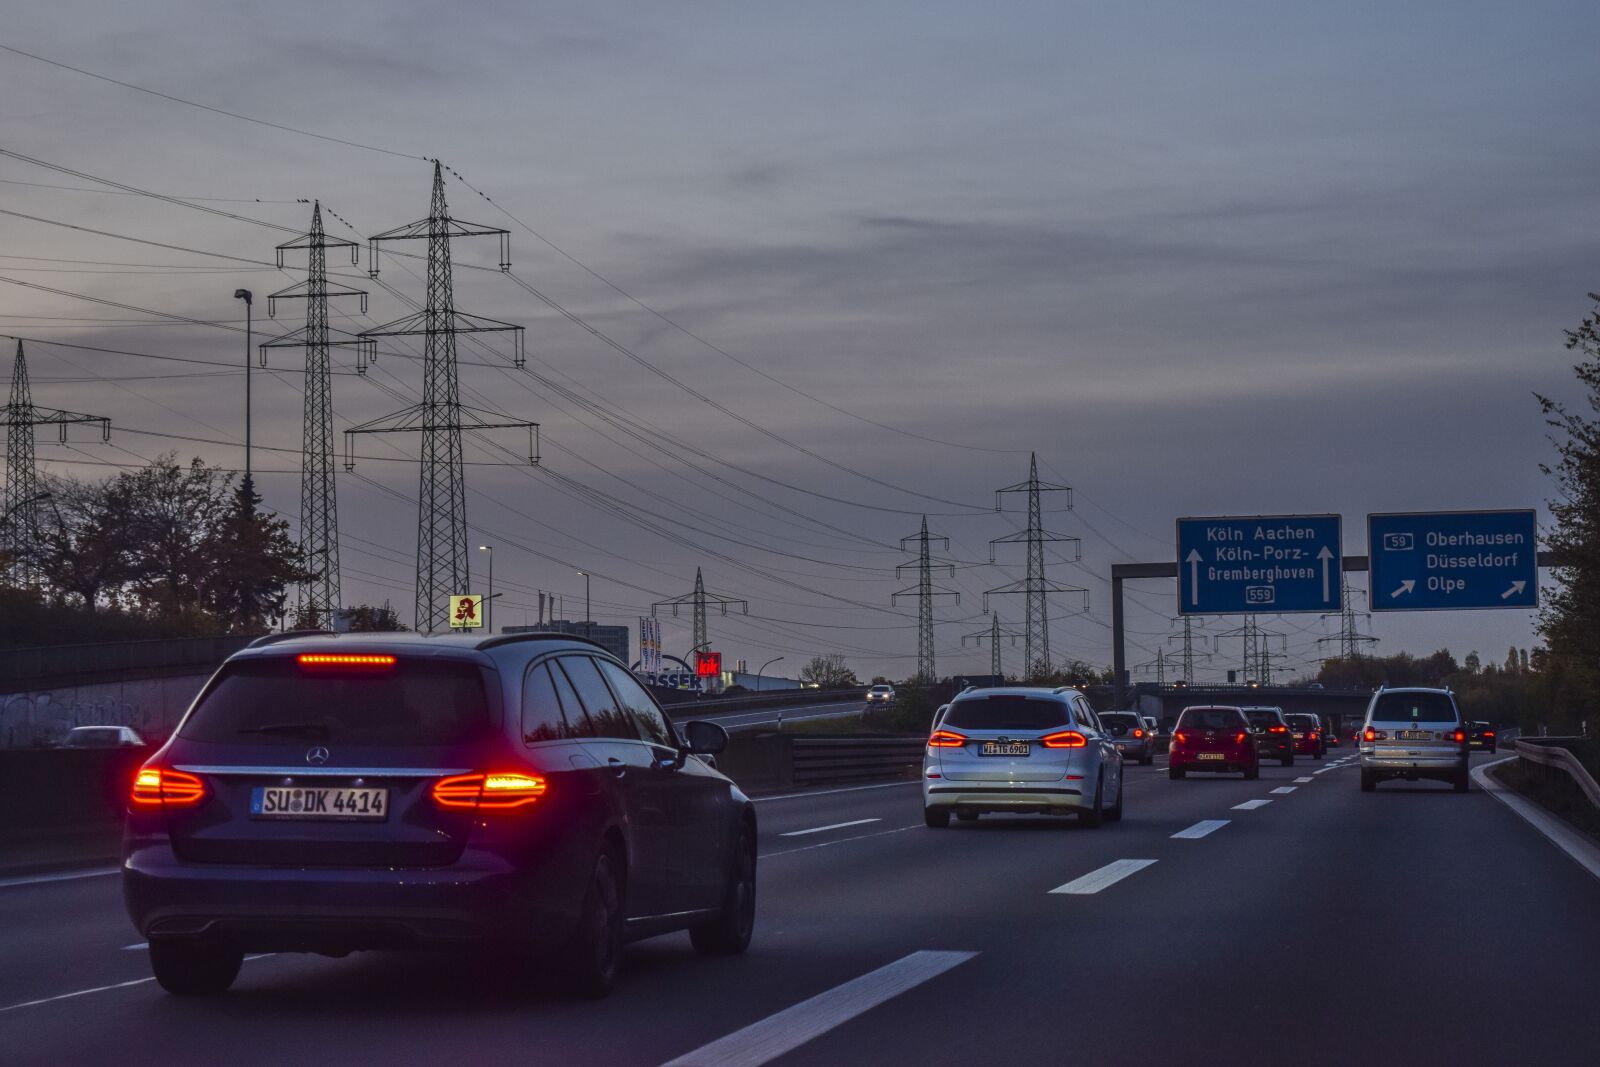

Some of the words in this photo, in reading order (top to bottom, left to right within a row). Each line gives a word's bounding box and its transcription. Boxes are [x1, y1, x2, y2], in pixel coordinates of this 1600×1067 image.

[1207, 527, 1243, 541] Köln
[1254, 526, 1315, 540] Aachen
[1426, 531, 1524, 546] Oberhausen
[1391, 536, 1406, 547] 59
[1216, 546, 1309, 561] Köln-Porz-
[1427, 552, 1518, 569] Düsseldorf
[1208, 565, 1315, 583] Gremberghoven
[1427, 576, 1466, 594] Olpe
[1249, 589, 1271, 601] 559
[983, 745, 993, 754] WI
[998, 745, 1008, 754] TG
[1009, 745, 1028, 754] 6901
[264, 790, 289, 813] SU
[303, 790, 329, 813] DK
[333, 791, 383, 813] 4414
